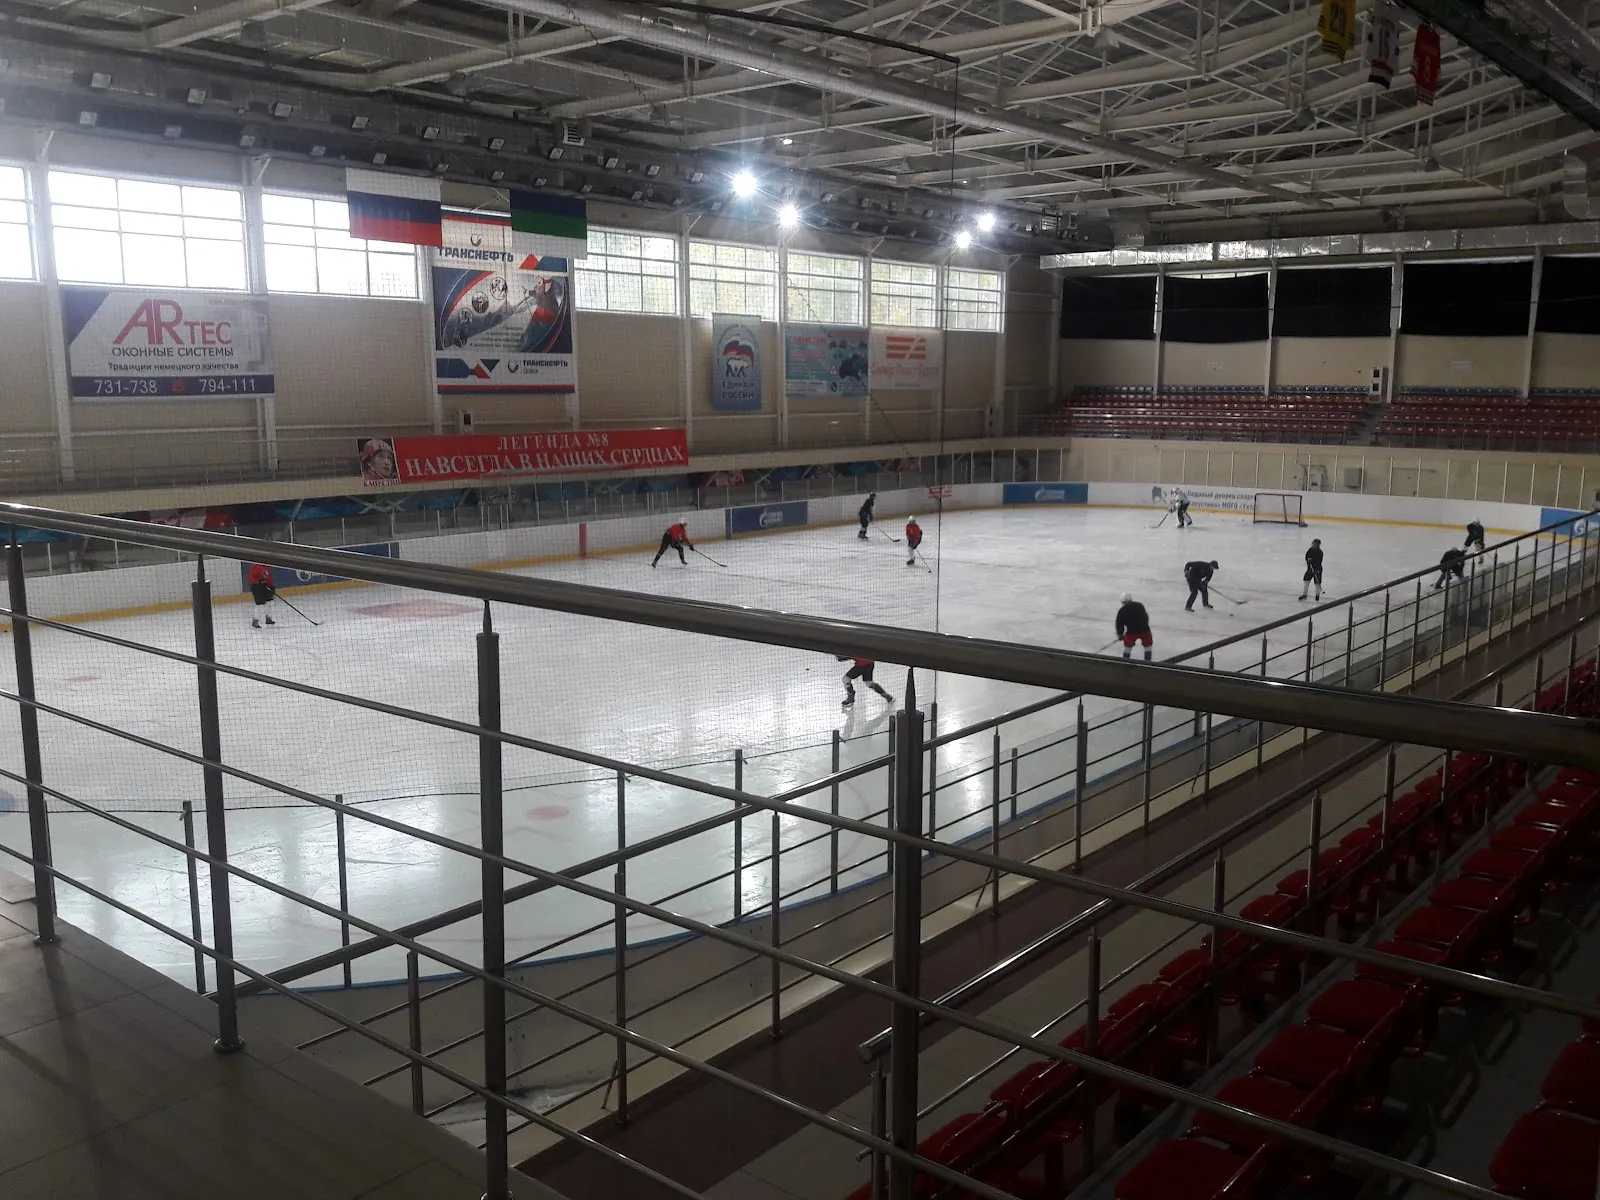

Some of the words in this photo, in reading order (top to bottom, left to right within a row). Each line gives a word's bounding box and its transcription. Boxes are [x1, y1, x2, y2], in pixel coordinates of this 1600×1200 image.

[1424, 55, 1431, 83] 8
[438, 246, 515, 263] ТРАНСНЕФТЬ
[111, 347, 174, 357] ОКОННЫЕ
[177, 347, 234, 357] СИСТЕМЫ
[108, 362, 152, 372] Традиции
[154, 363, 201, 372] немецкого
[202, 362, 239, 370] качества
[522, 359, 568, 367] ТРАНСНЕФТЬ
[94, 379, 158, 394] 731-738
[199, 377, 256, 393] 794-111
[497, 434, 581, 450] ЛЕГЕНДА
[405, 454, 516, 477] НАВСЕГДА
[518, 453, 533, 471] В
[535, 450, 608, 470] НАШИХ
[610, 445, 684, 465] СЕРДЦАХ
